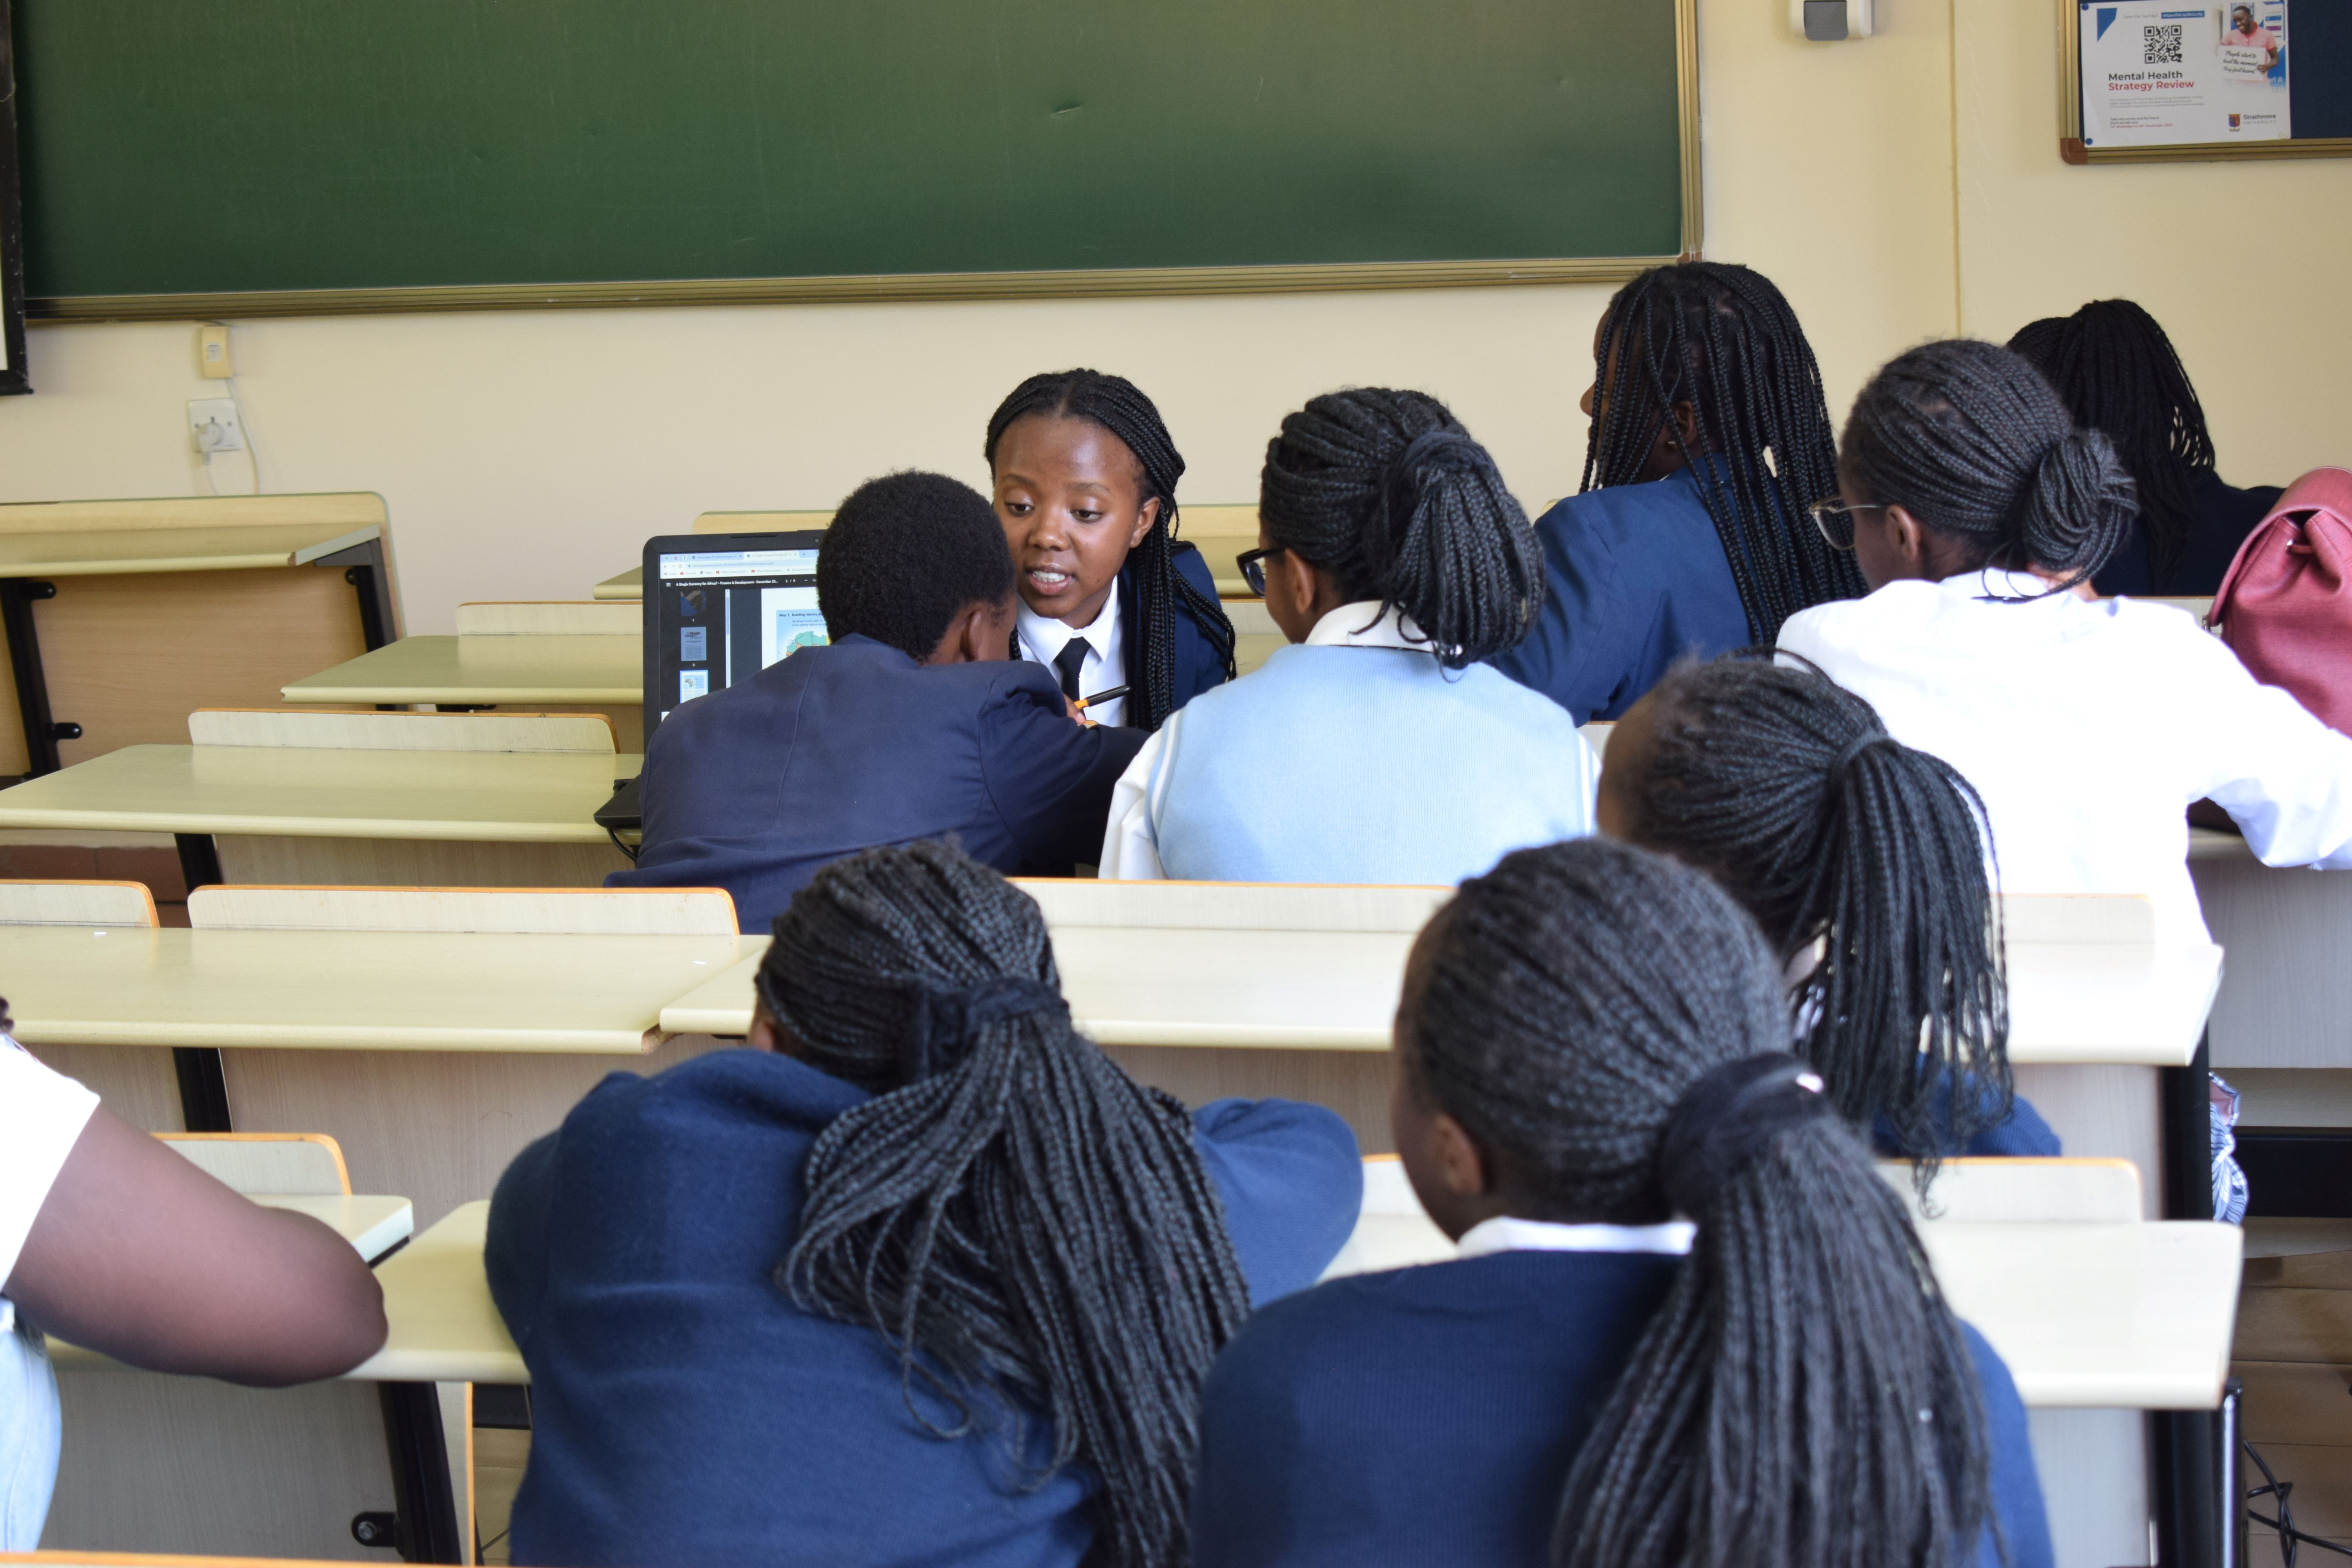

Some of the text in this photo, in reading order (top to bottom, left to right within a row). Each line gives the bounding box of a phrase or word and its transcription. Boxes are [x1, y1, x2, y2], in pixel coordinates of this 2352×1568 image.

[2109, 71, 2182, 81] Mental Health
[2109, 80, 2194, 91] Strategy Review
